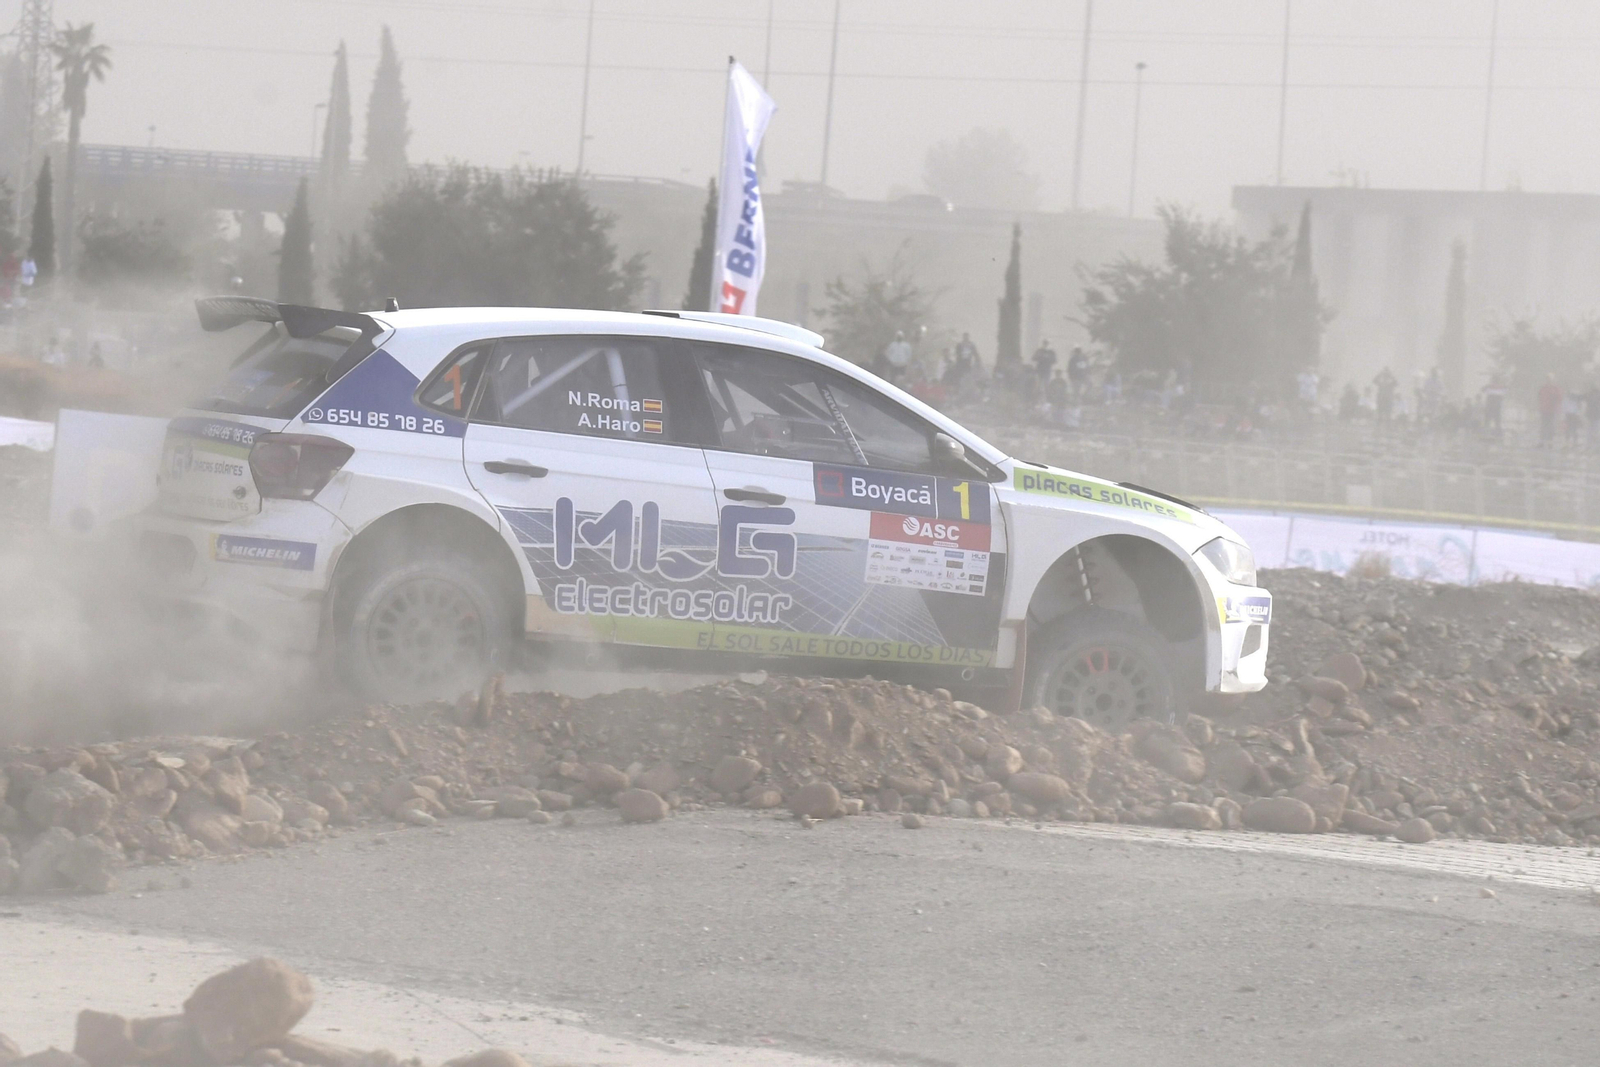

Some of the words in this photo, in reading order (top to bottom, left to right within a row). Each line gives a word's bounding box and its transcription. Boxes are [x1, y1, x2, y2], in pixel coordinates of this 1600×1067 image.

[444, 364, 461, 410] 1
[568, 390, 640, 412] N.Roma
[327, 408, 361, 425] 654
[367, 411, 389, 428] 85
[395, 414, 416, 430] 78
[422, 417, 445, 434] 26
[577, 412, 640, 433] A.Haro
[242, 430, 255, 444] 26
[953, 481, 970, 519] 1
[919, 522, 960, 541] ASC
[231, 544, 301, 561] MICHELIN
[696, 631, 719, 649] EL
[725, 633, 763, 651] SOL
[769, 635, 818, 654] SALE
[822, 638, 892, 659] TODOS
[897, 642, 933, 660] LOS
